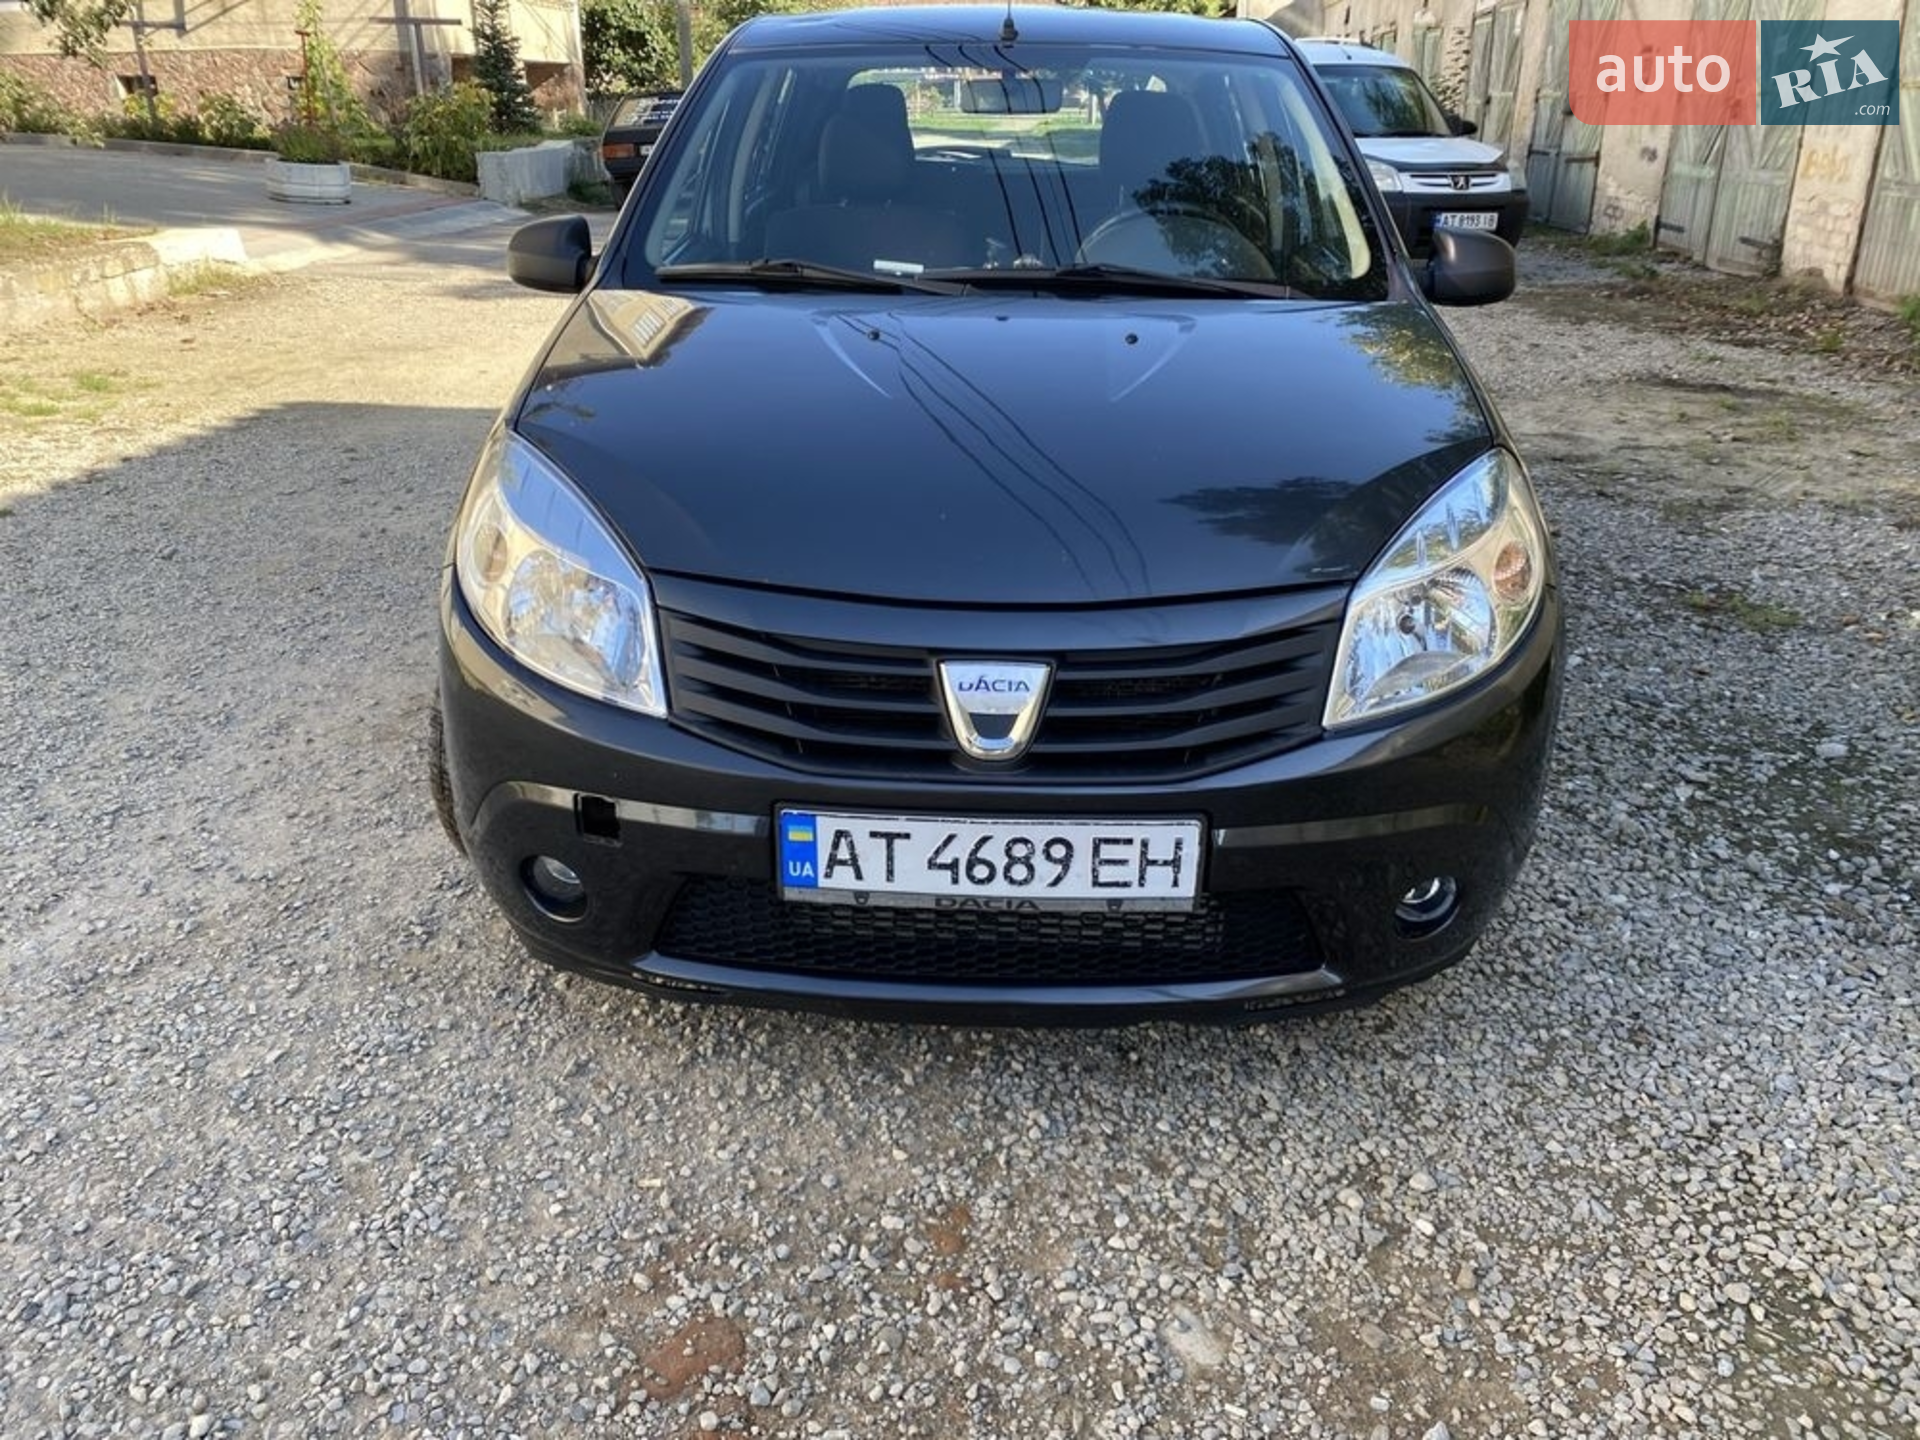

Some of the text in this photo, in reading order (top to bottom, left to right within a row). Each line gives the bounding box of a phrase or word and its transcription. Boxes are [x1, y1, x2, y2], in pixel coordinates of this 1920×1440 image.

[1443, 214, 1458, 227] AT
[823, 829, 1184, 888] AT 4689 EH
[788, 861, 815, 878] UA
[935, 897, 1041, 911] DACIA
